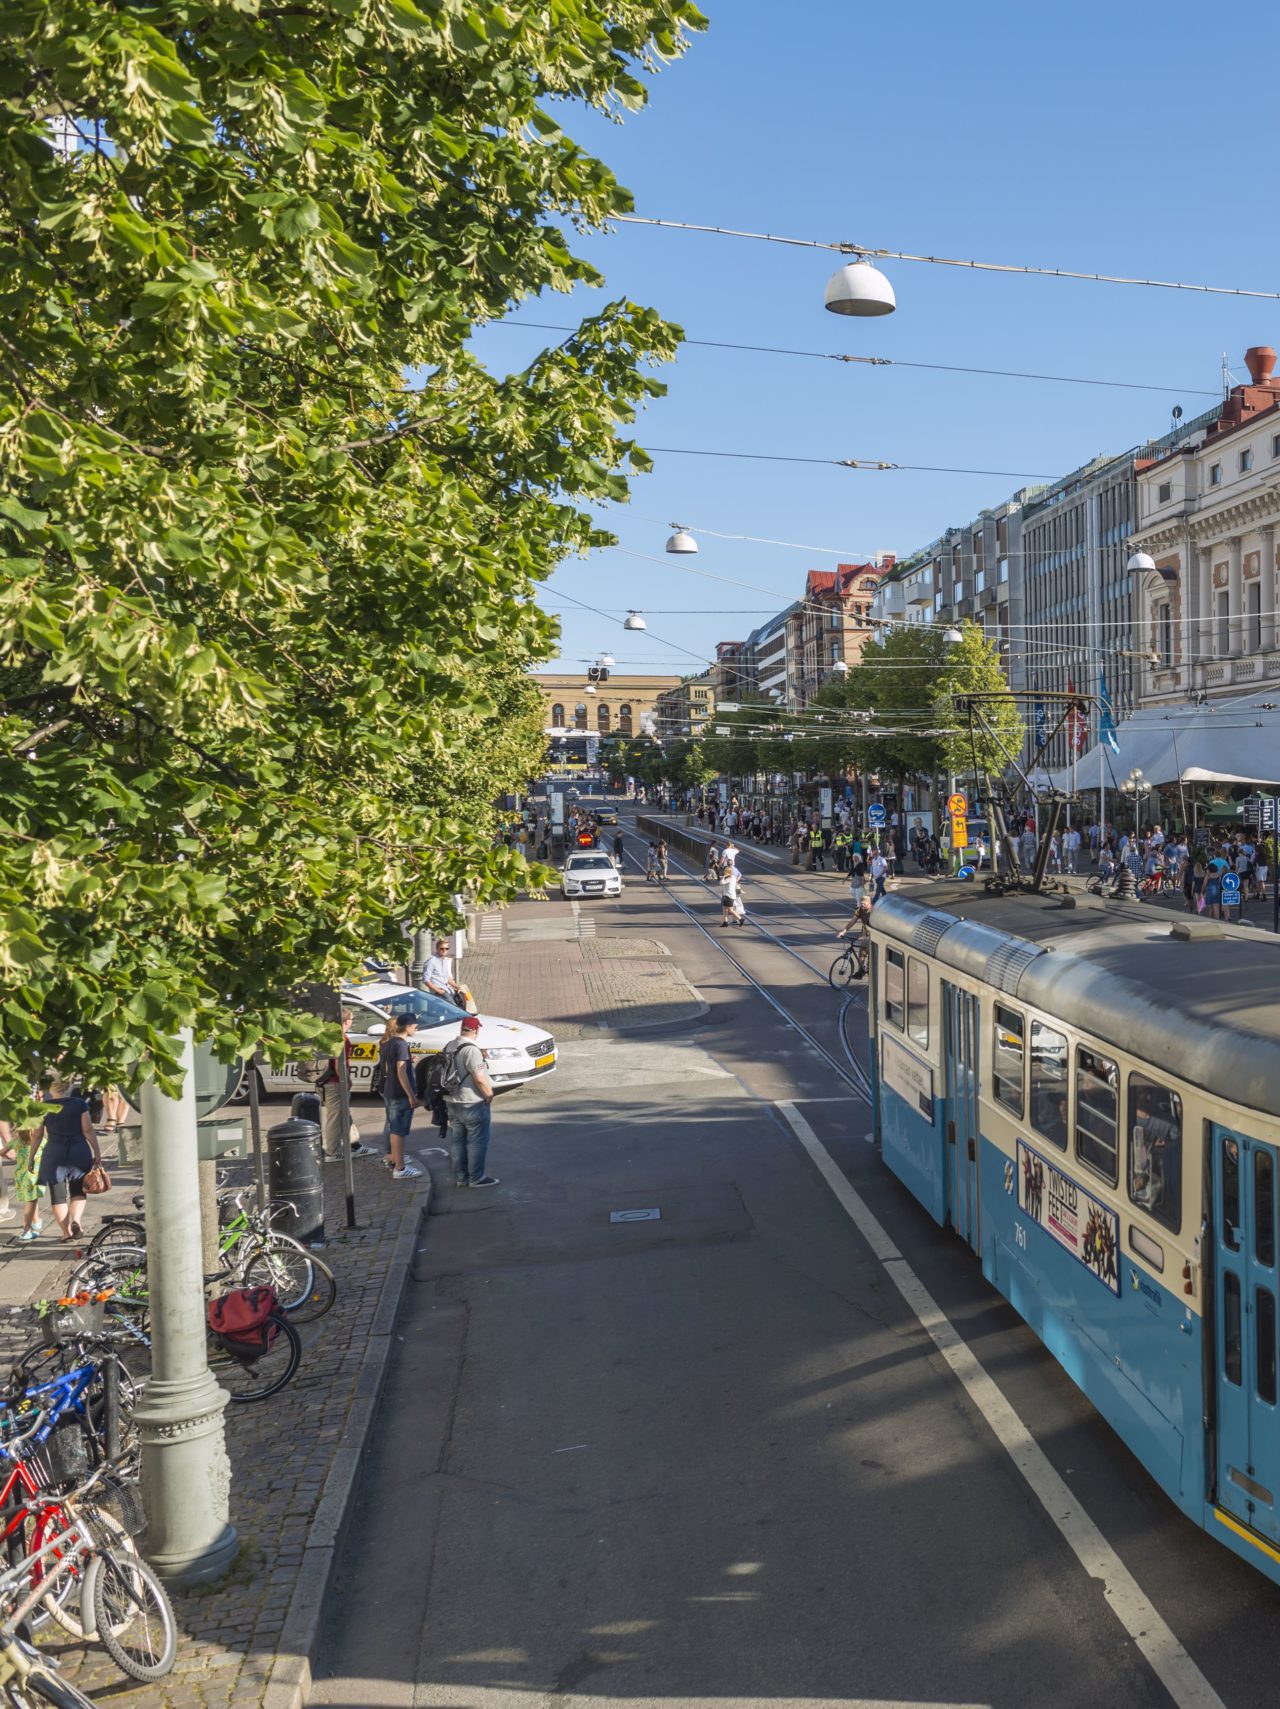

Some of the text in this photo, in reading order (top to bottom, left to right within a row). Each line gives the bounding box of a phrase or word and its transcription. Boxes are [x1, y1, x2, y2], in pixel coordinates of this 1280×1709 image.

[1047, 1165, 1078, 1211] TWISTED
[1048, 1190, 1063, 1224] FEET
[1014, 1221, 1027, 1251] 761
[123, 1320, 152, 1349] GIAN
